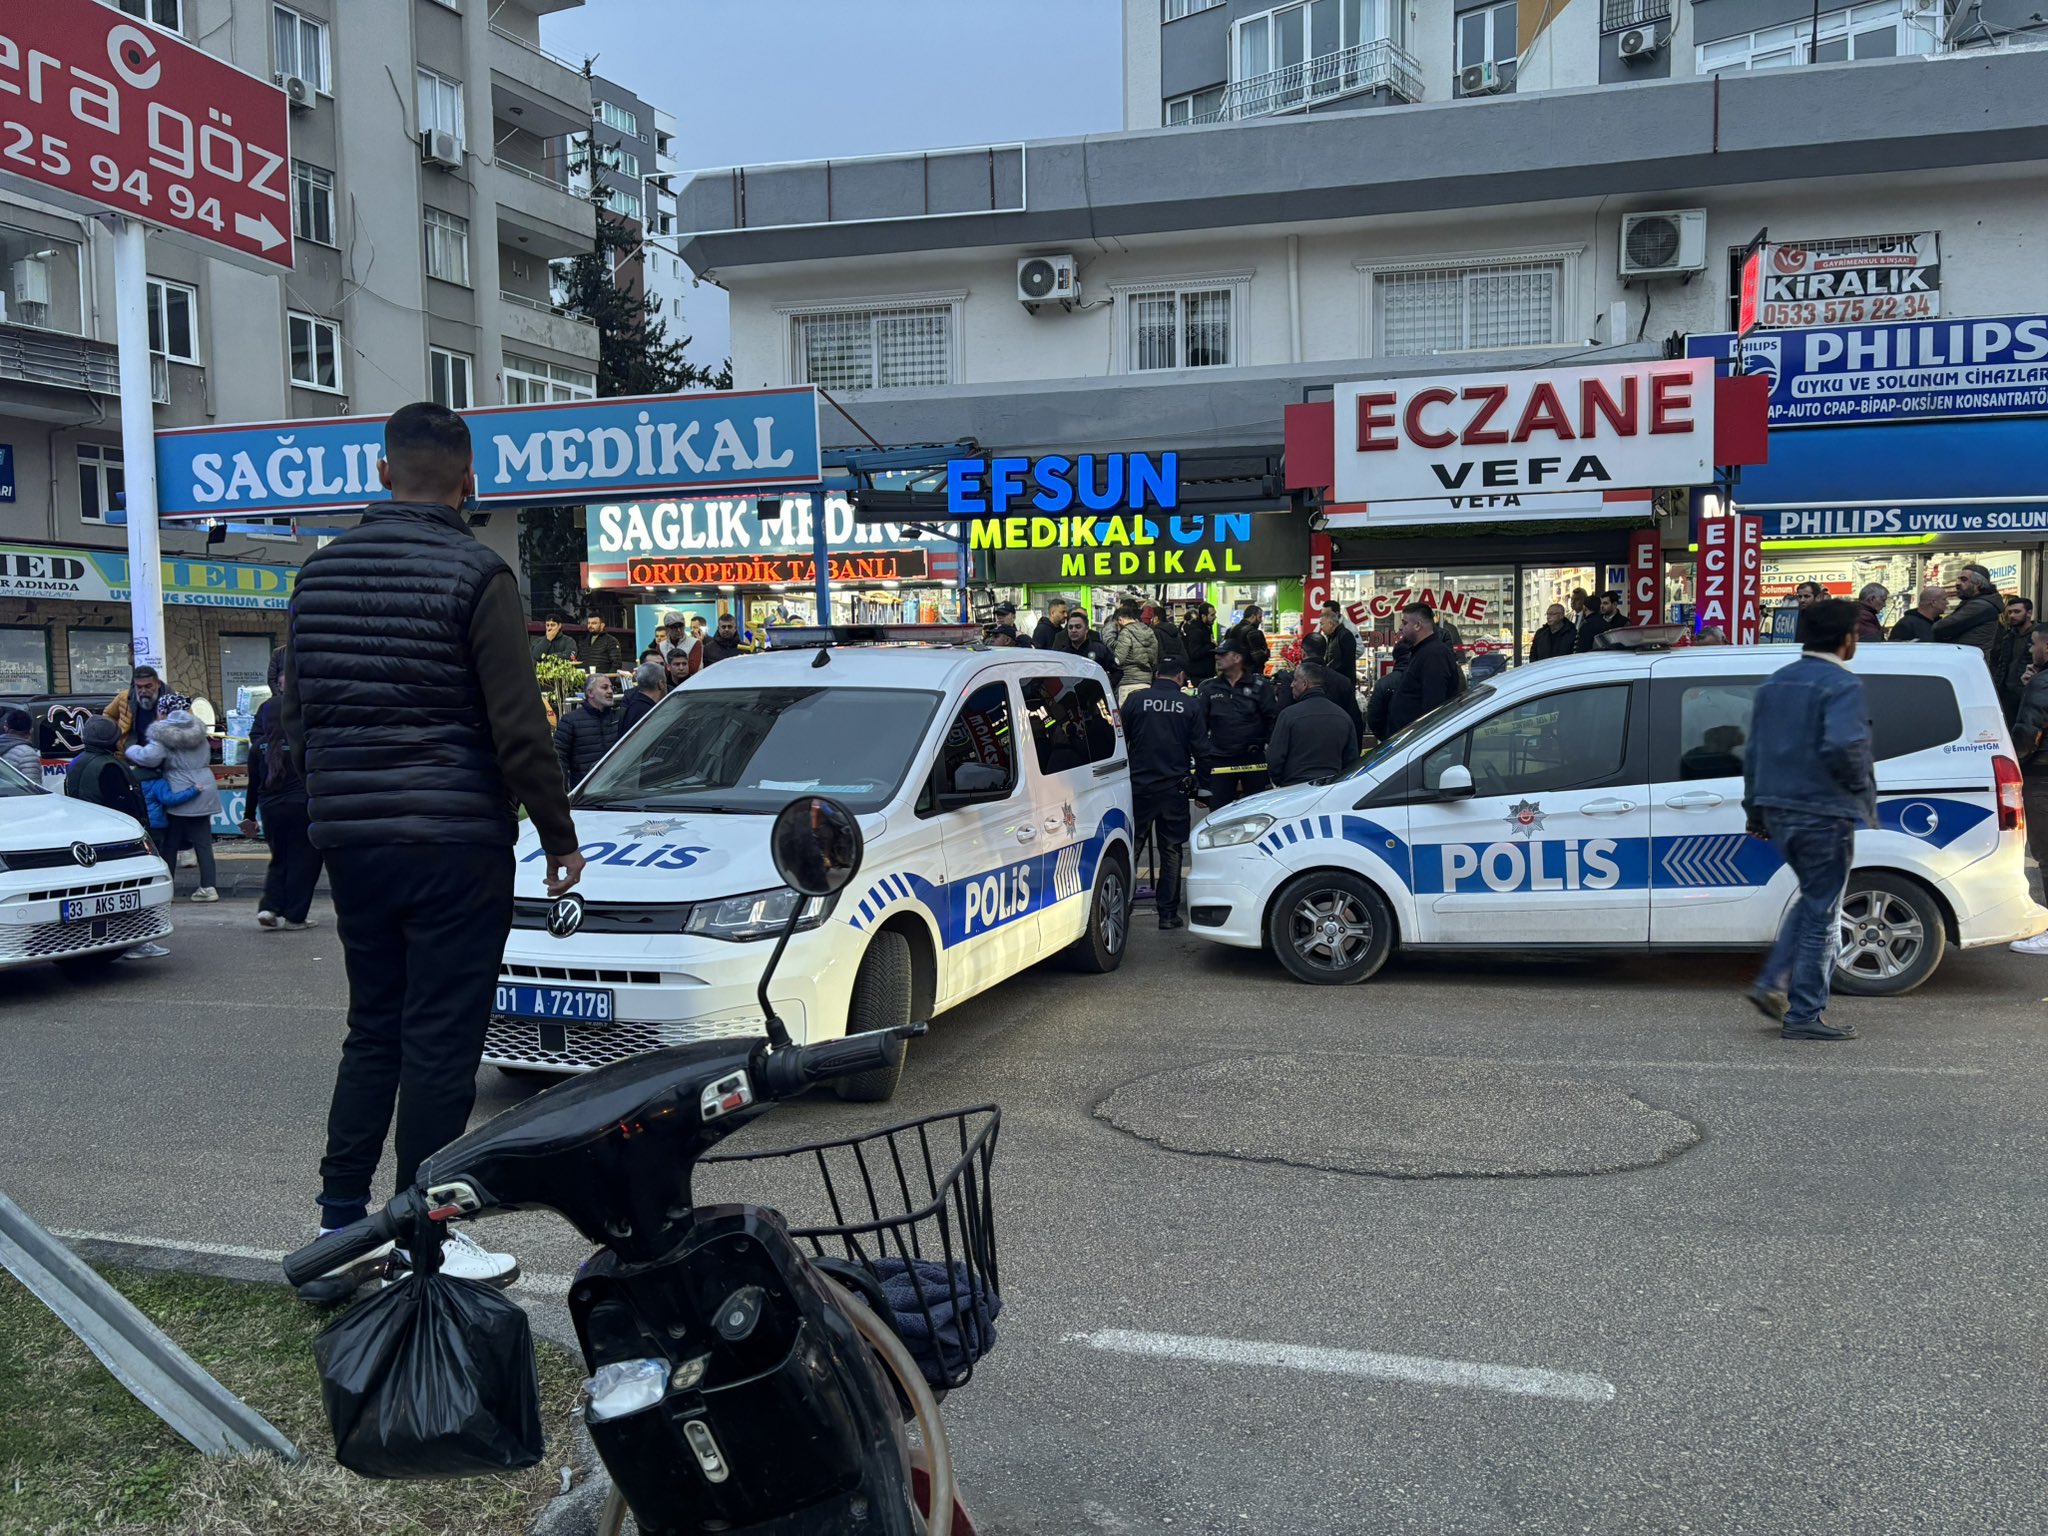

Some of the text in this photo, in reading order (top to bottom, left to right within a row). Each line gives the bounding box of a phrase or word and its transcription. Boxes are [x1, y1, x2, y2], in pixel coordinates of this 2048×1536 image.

[147, 102, 287, 201] göz
[3, 121, 225, 232] 25 94 94
[1764, 294, 1930, 325] 0533 575 22 34
[1733, 341, 1777, 352] PHILIPS
[1805, 320, 2048, 372] PHILIPS
[1797, 378, 1843, 394] UYKU
[1850, 377, 1870, 391] VE
[1877, 372, 1959, 390] SOLUNUM
[1355, 371, 1695, 452] ECZANE
[493, 411, 794, 484] MEDİKAL
[948, 452, 1177, 513] EFSUN
[1430, 455, 1612, 489] VEFA
[1449, 494, 1521, 508] VEFA
[1780, 509, 1901, 534] PHILIPS
[1909, 514, 1957, 531] UYKU
[1962, 516, 1983, 529] ve
[15, 580, 80, 591] ADIMDA
[633, 557, 779, 584] ORTOPEDİK
[185, 593, 259, 607] SOLUNUM
[1346, 587, 1489, 625] ECZANE
[1943, 743, 2000, 754] @EmniyetGM
[69, 901, 83, 918] 33
[95, 896, 115, 914] AKS
[120, 893, 138, 910] 597
[496, 986, 608, 1018] 01 A 72178
